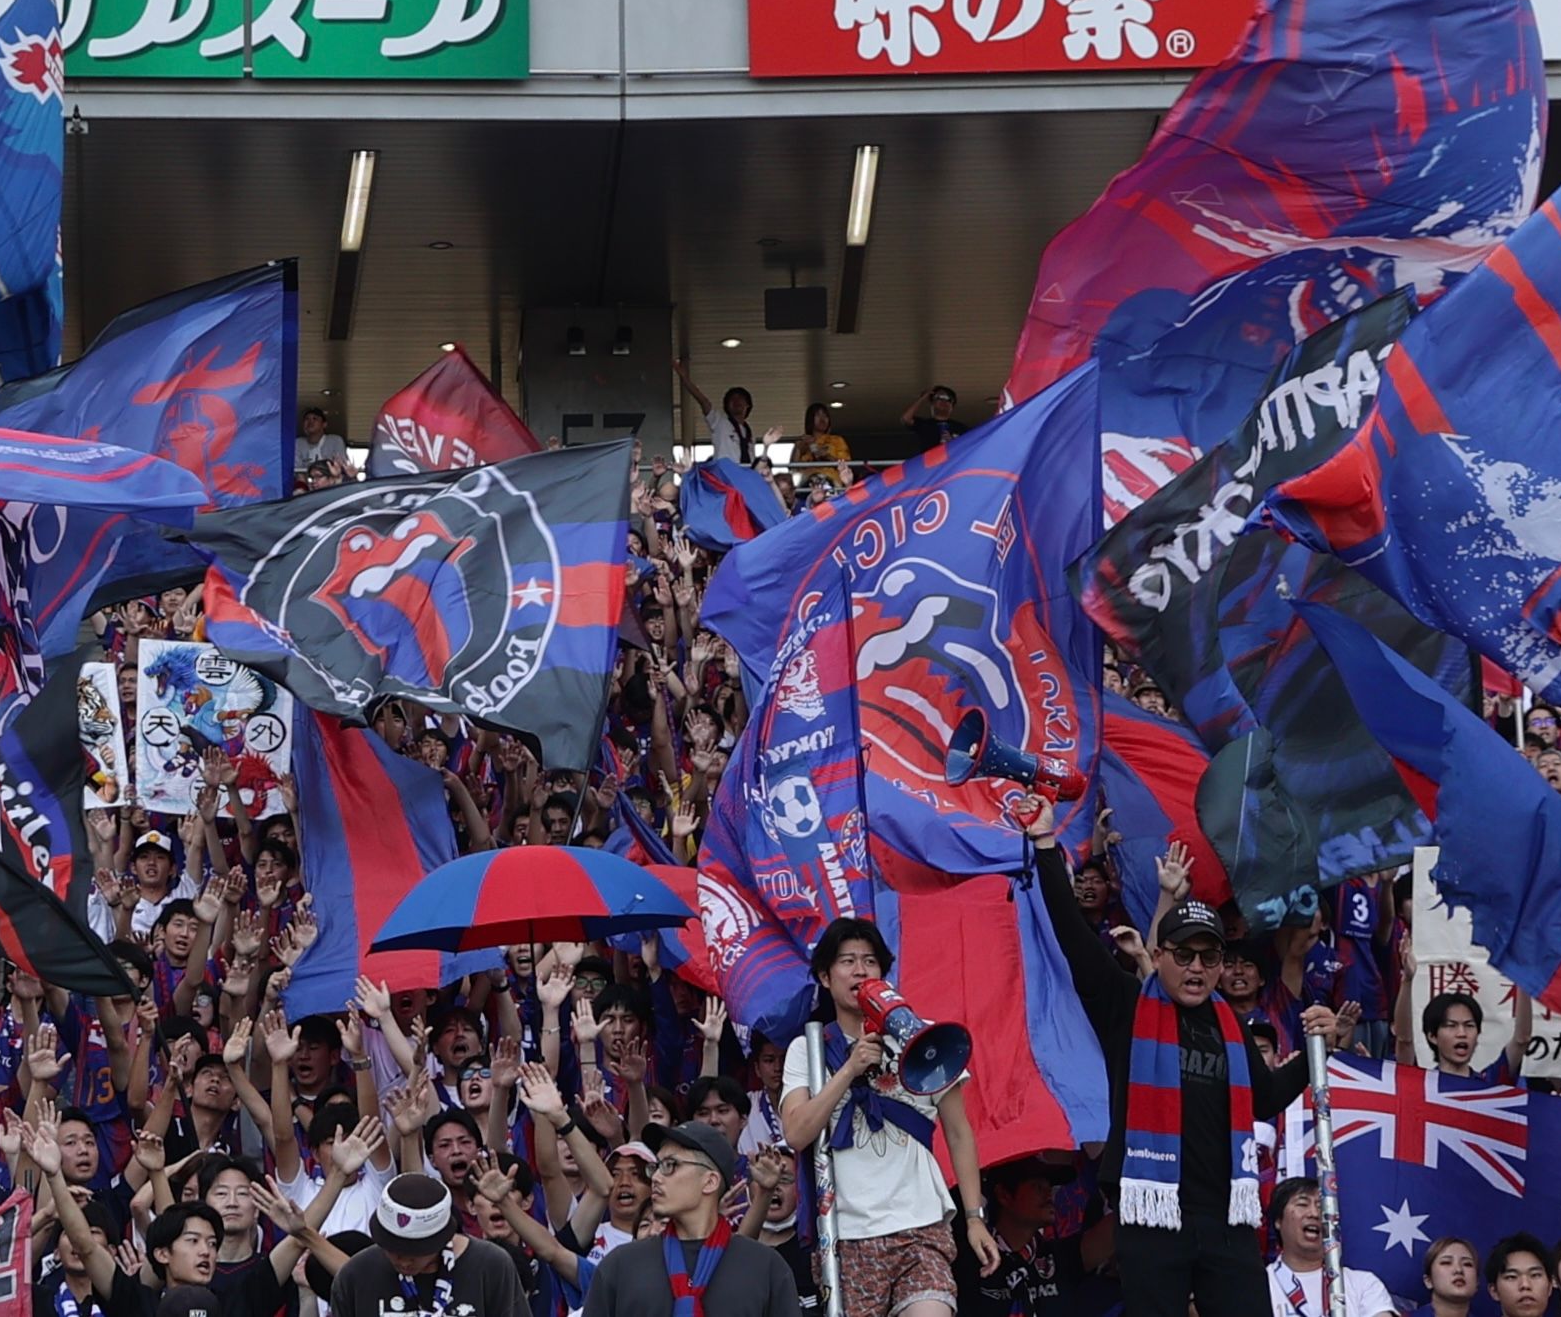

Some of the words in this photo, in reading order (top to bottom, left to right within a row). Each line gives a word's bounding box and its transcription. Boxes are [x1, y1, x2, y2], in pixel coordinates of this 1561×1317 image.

[198, 654, 232, 679] 雲
[146, 715, 177, 739] 天
[250, 723, 279, 745] 外
[1352, 892, 1369, 922] 3
[1127, 1147, 1176, 1162] bombonera
